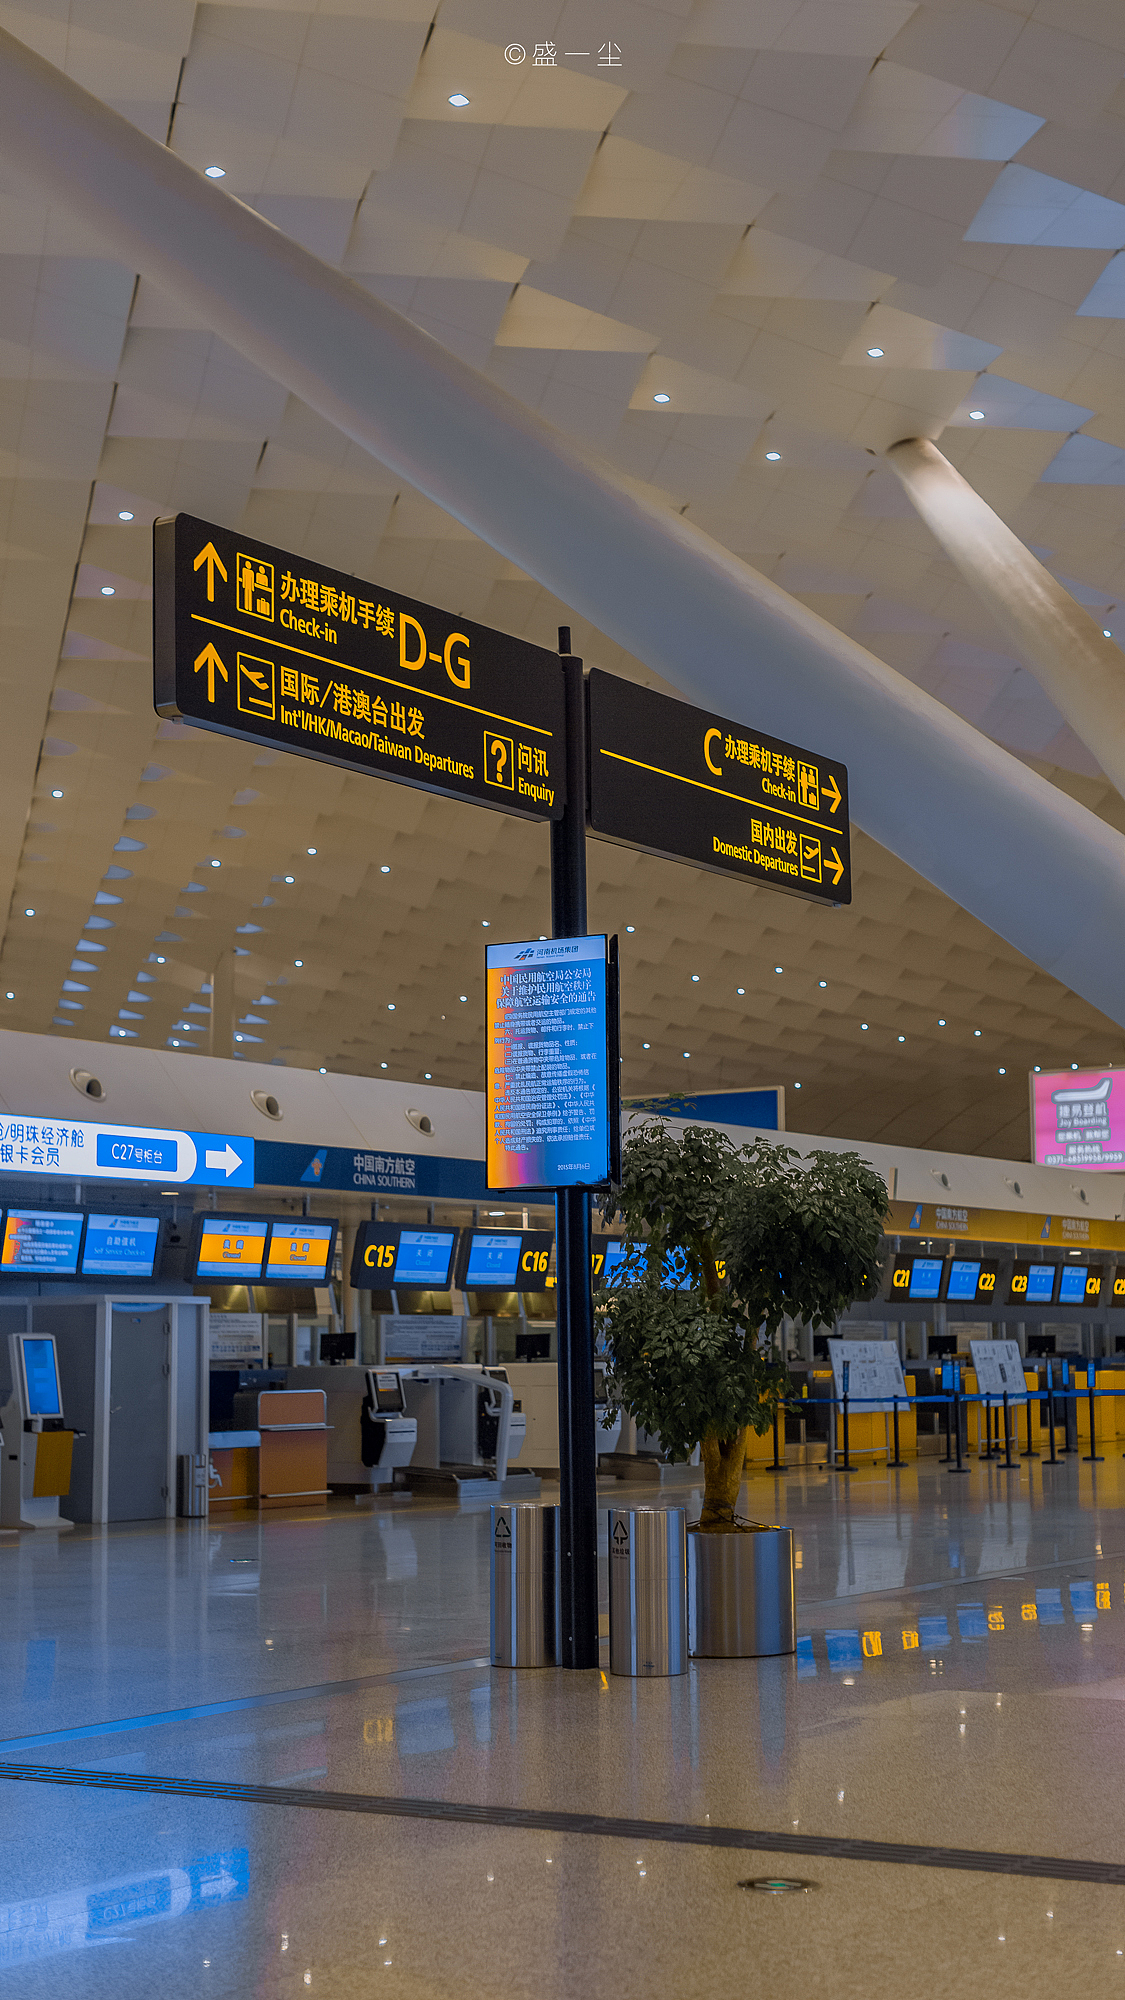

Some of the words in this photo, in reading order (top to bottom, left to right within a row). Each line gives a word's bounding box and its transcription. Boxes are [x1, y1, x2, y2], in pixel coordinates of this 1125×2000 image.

[280, 571, 395, 639] 办理乘机手续
[279, 608, 338, 645] Check-in
[399, 613, 471, 689] D-G
[280, 705, 412, 762] Int'l/HK/Macao/Taiwan
[414, 748, 474, 779] Departures
[704, 728, 722, 776] C
[518, 743, 549, 777] 问讯
[725, 734, 795, 782] 办理乘机手续
[518, 777, 555, 807] Enquiry
[761, 777, 796, 803] Check-in
[751, 818, 798, 857] 国内出发
[713, 836, 753, 863] Domestic
[753, 851, 799, 877] Departures
[500, 968, 592, 985] 中国民用航空局公安局
[501, 980, 592, 997] 关于维护民用航空秩序
[496, 992, 596, 1009] 保障航空运输安全的通告
[111, 1143, 163, 1164] C27号柜台
[353, 1153, 415, 1176] 中国南方航空
[353, 1172, 377, 1186] CHINA
[377, 1174, 415, 1189] SOUTHERN
[364, 1245, 395, 1267] C15
[522, 1251, 548, 1272] C16
[893, 1269, 910, 1287] C21
[979, 1273, 995, 1290] C22
[1012, 1275, 1028, 1292] C23
[1114, 1279, 1125, 1295] C2
